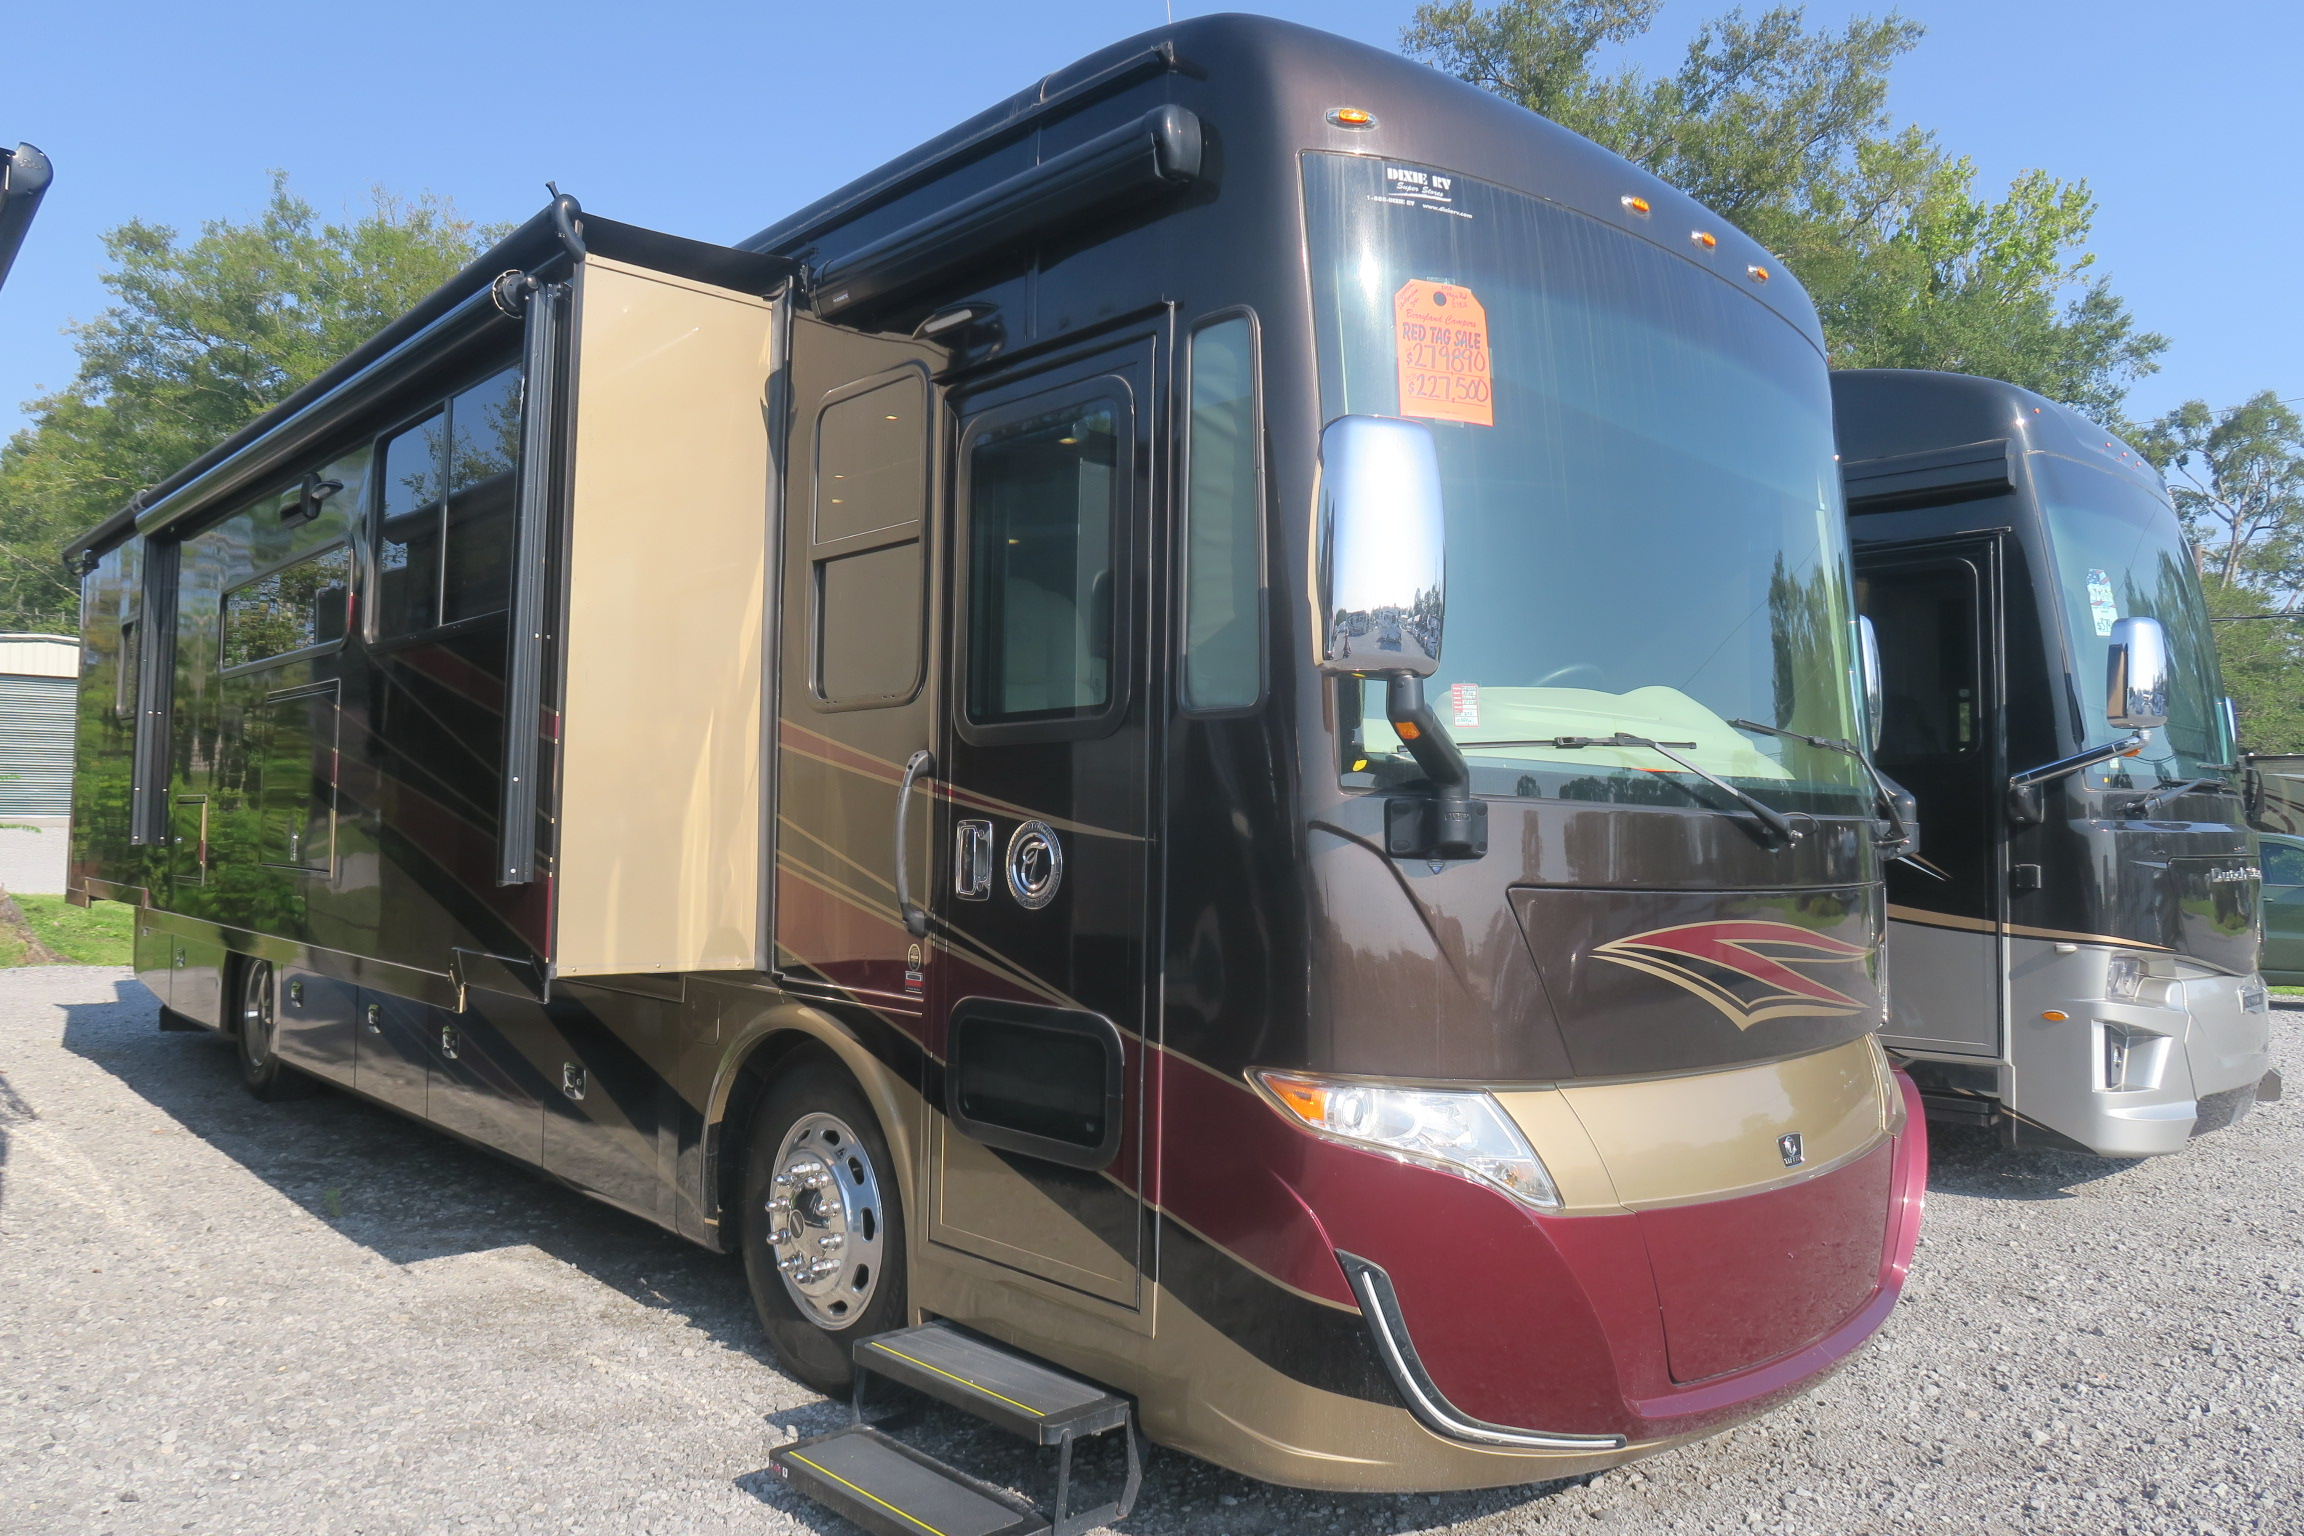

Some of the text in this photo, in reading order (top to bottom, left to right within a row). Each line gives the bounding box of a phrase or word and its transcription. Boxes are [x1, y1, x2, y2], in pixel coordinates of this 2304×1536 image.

[1387, 167, 1451, 190] DIXIE RV
[1396, 182, 1444, 197] Super Stores
[1422, 203, 1473, 219] www.dixierv.com
[1406, 309, 1477, 328] Berryland Campers
[1403, 322, 1481, 349] RED TAG SALE
